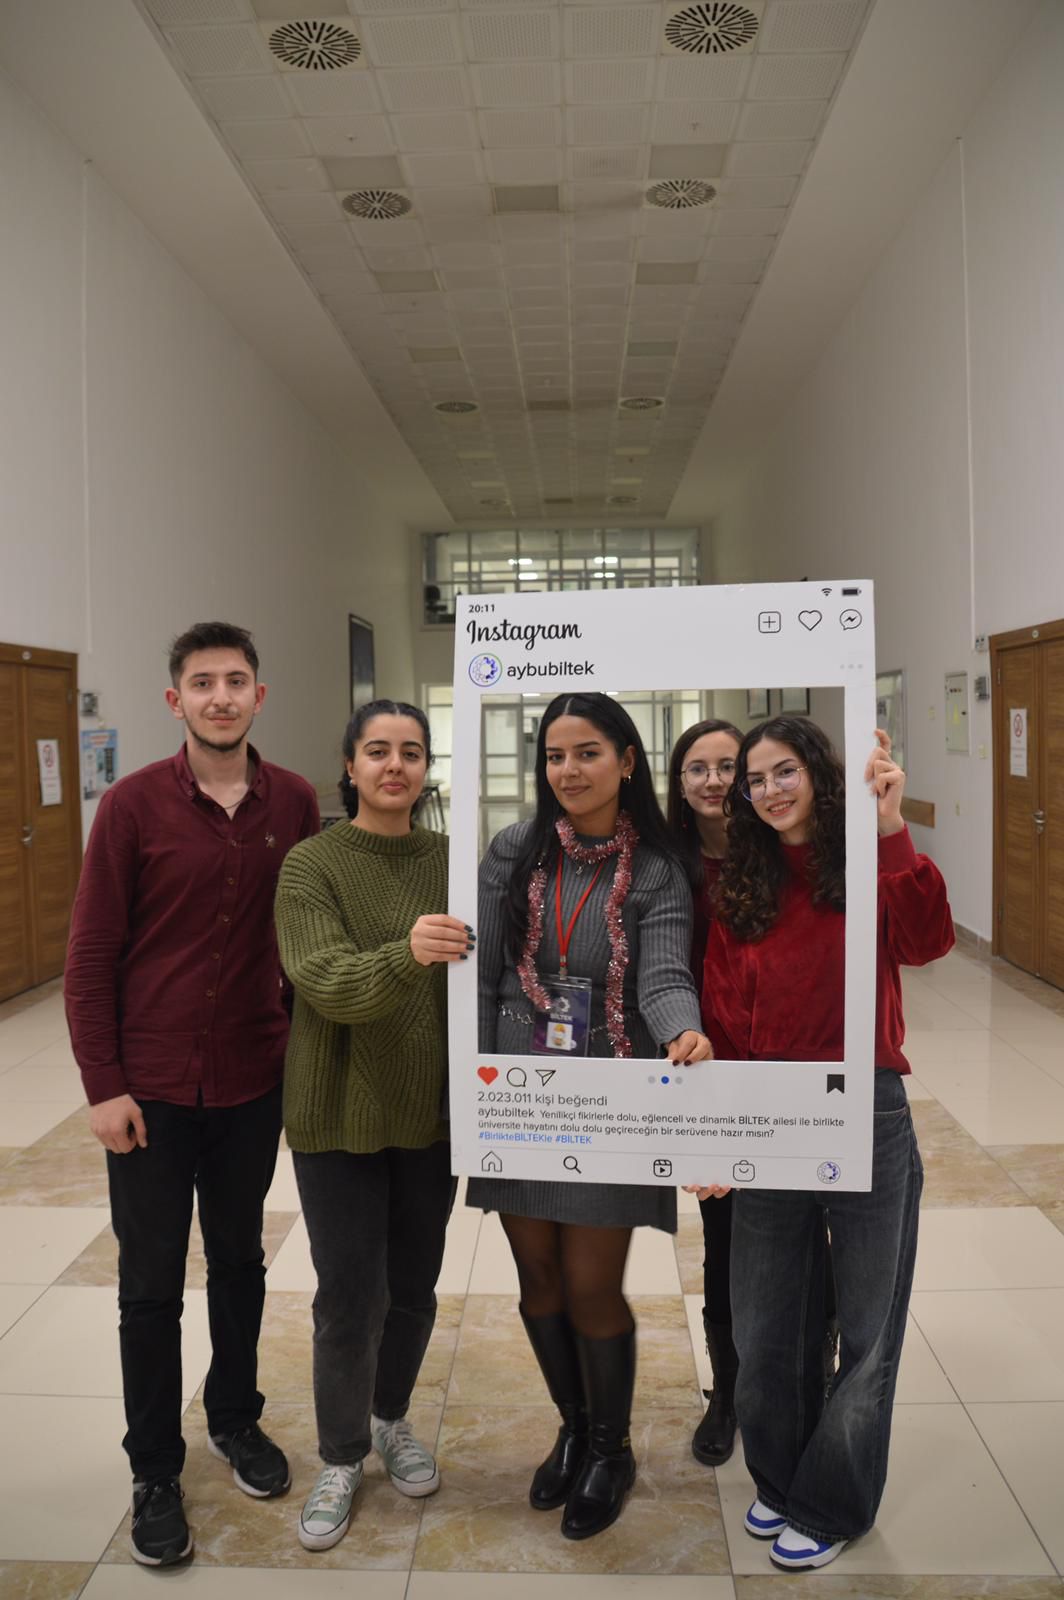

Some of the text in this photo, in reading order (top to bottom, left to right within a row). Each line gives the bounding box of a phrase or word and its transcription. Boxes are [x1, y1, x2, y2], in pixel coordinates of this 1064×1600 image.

[468, 603, 496, 614] 20:11
[467, 618, 582, 650] Instagram
[506, 661, 595, 679] aybubiltek
[477, 1091, 608, 1107] 2.023.011 kişi beğendi
[478, 1107, 845, 1127] aybubiltek Yenilikçi fikirlerle dolu, eğlenceli ve dinamik BİLTEK ailesi ile birlikte
[478, 1120, 774, 1138] üniversite hayatını dolu dolu geçireceğin bir serüvene hazır mısın?
[479, 1131, 592, 1144] #BirlikteBİLTEKle #BİLTEK
